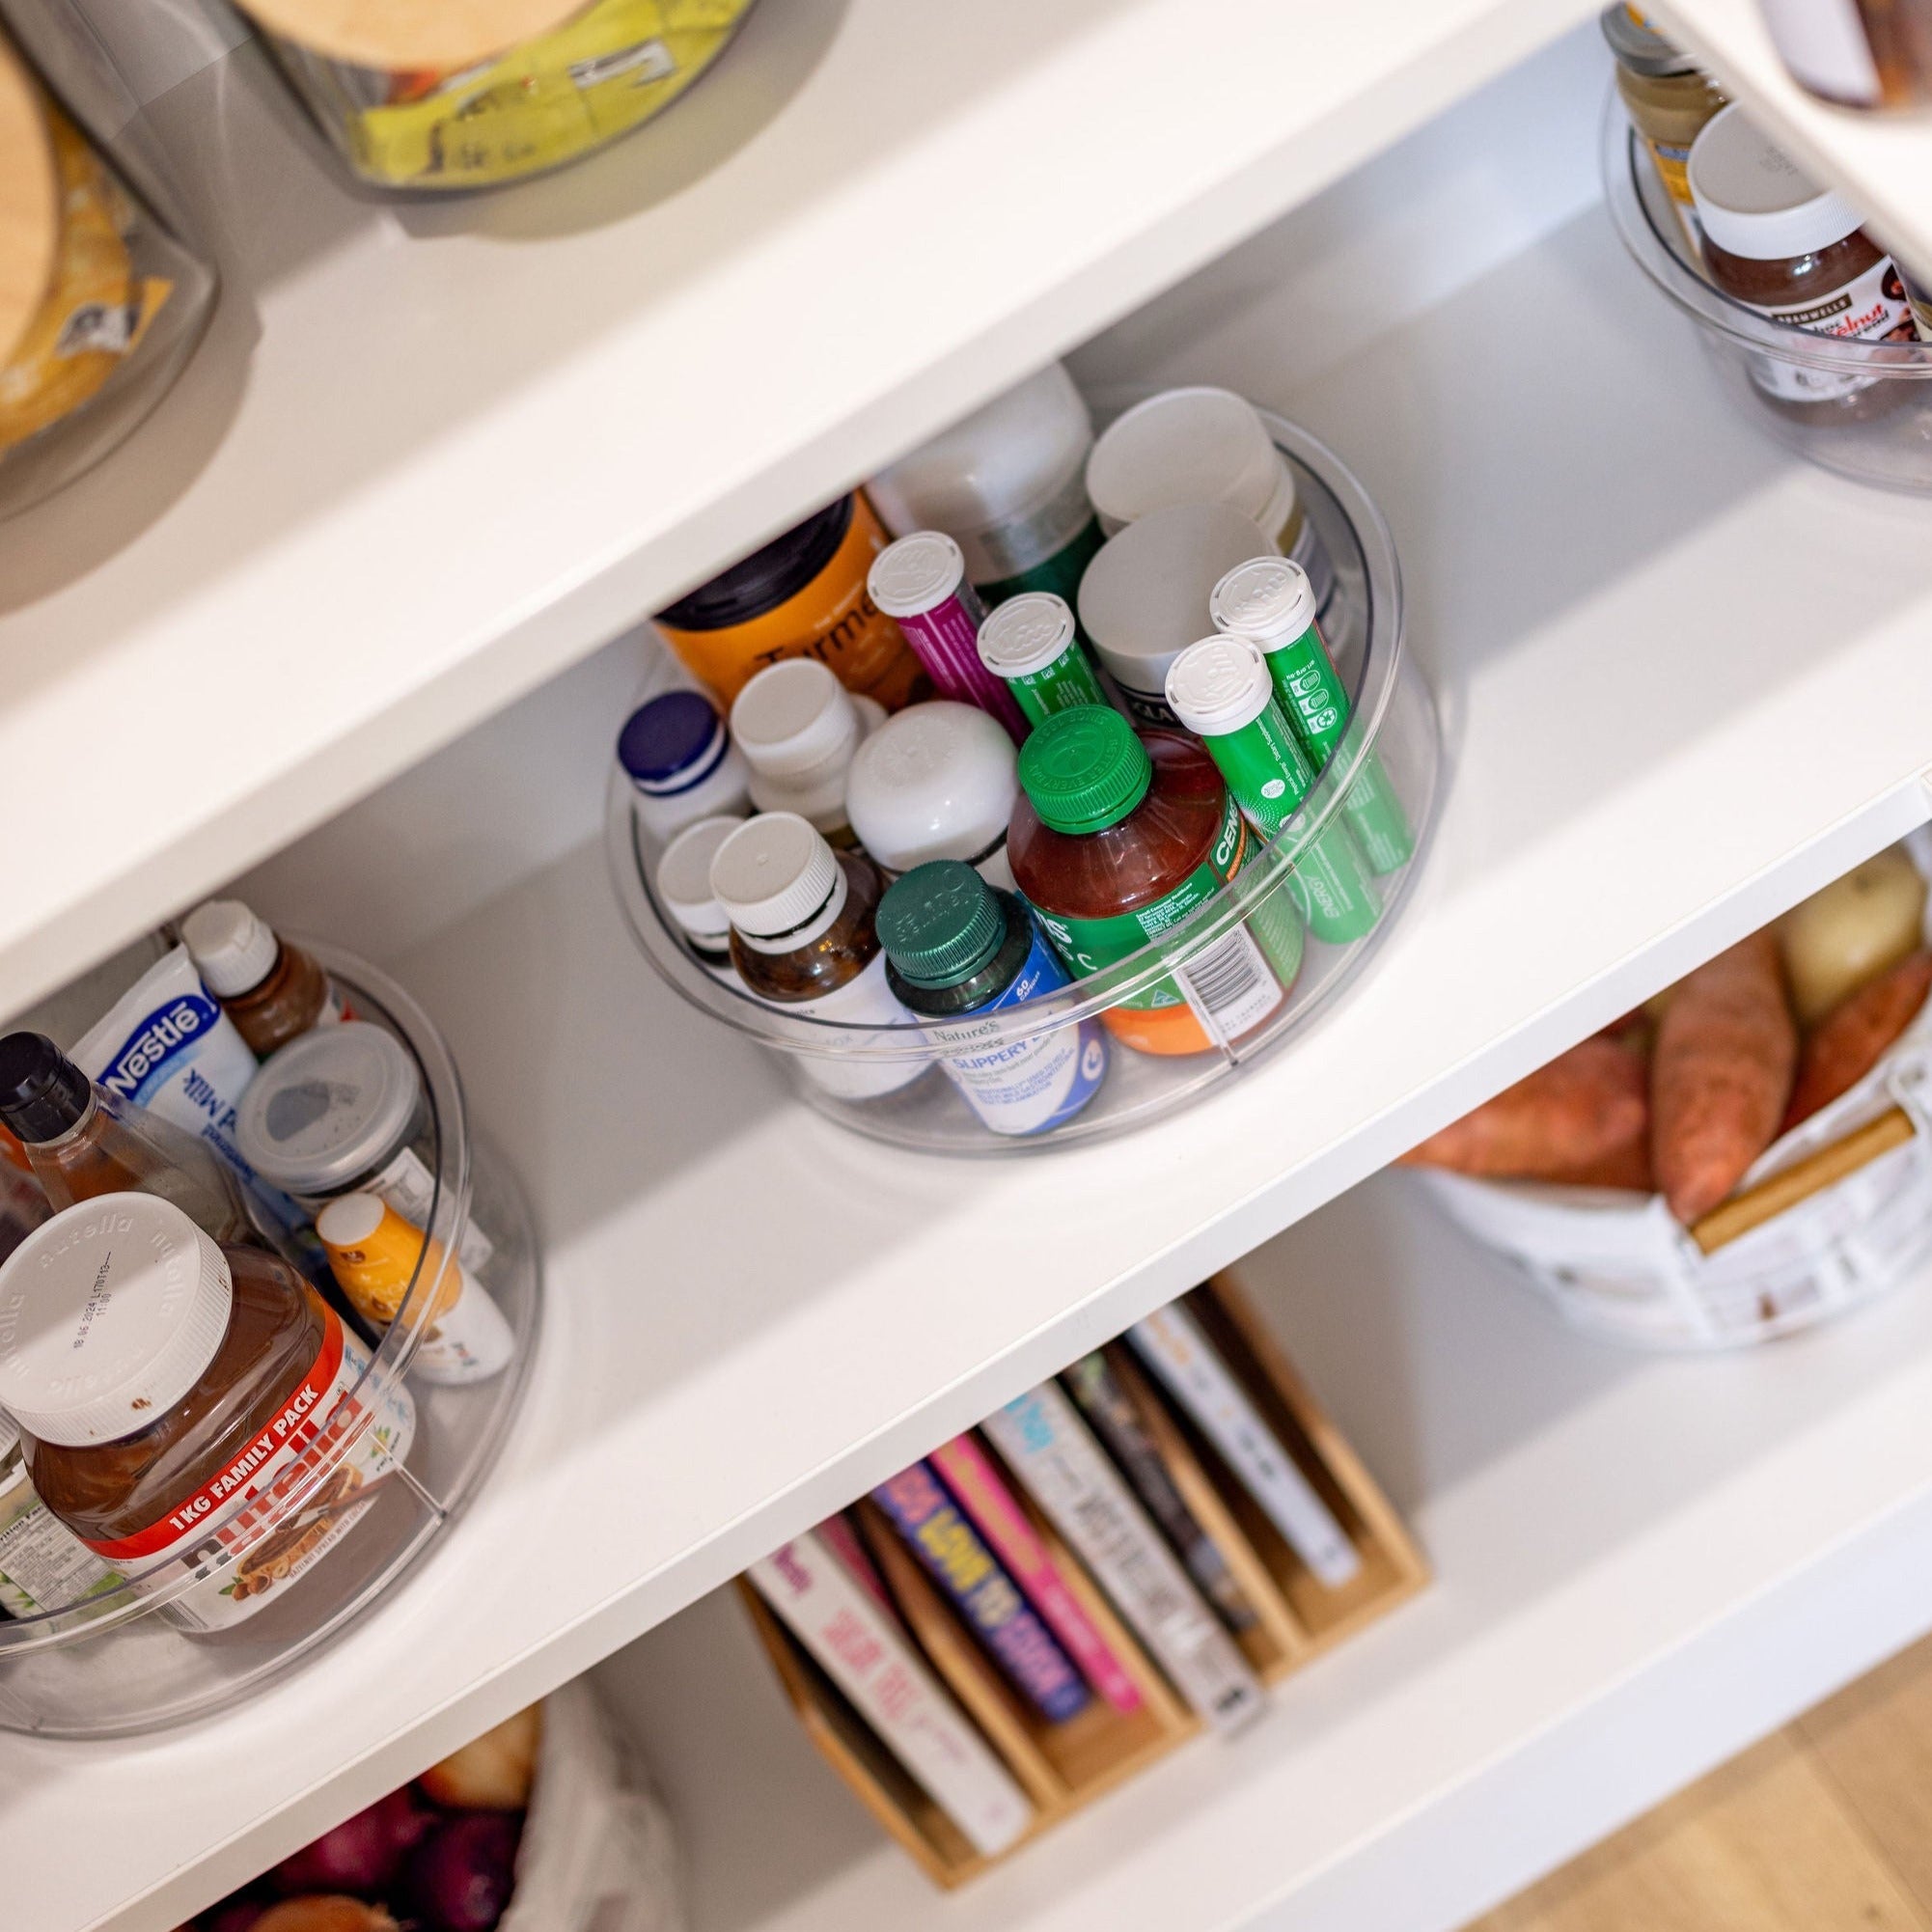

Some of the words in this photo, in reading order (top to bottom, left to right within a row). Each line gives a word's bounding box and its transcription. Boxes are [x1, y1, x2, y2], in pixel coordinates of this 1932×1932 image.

[1149, 897, 1172, 912] Consumer
[1171, 882, 1192, 900] Healthcare
[1015, 980, 1029, 996] 60
[1019, 971, 1039, 1001] CAPSULES
[932, 1018, 1000, 1041] Nature's
[952, 1041, 1027, 1068] SLIPPERY
[181, 1068, 225, 1118] Milk
[83, 1301, 98, 1326] 2024
[169, 1493, 212, 1531] 1KG
[210, 1433, 269, 1499] FAMILY
[272, 1384, 318, 1437] PACK
[179, 1389, 374, 1582] nutella
